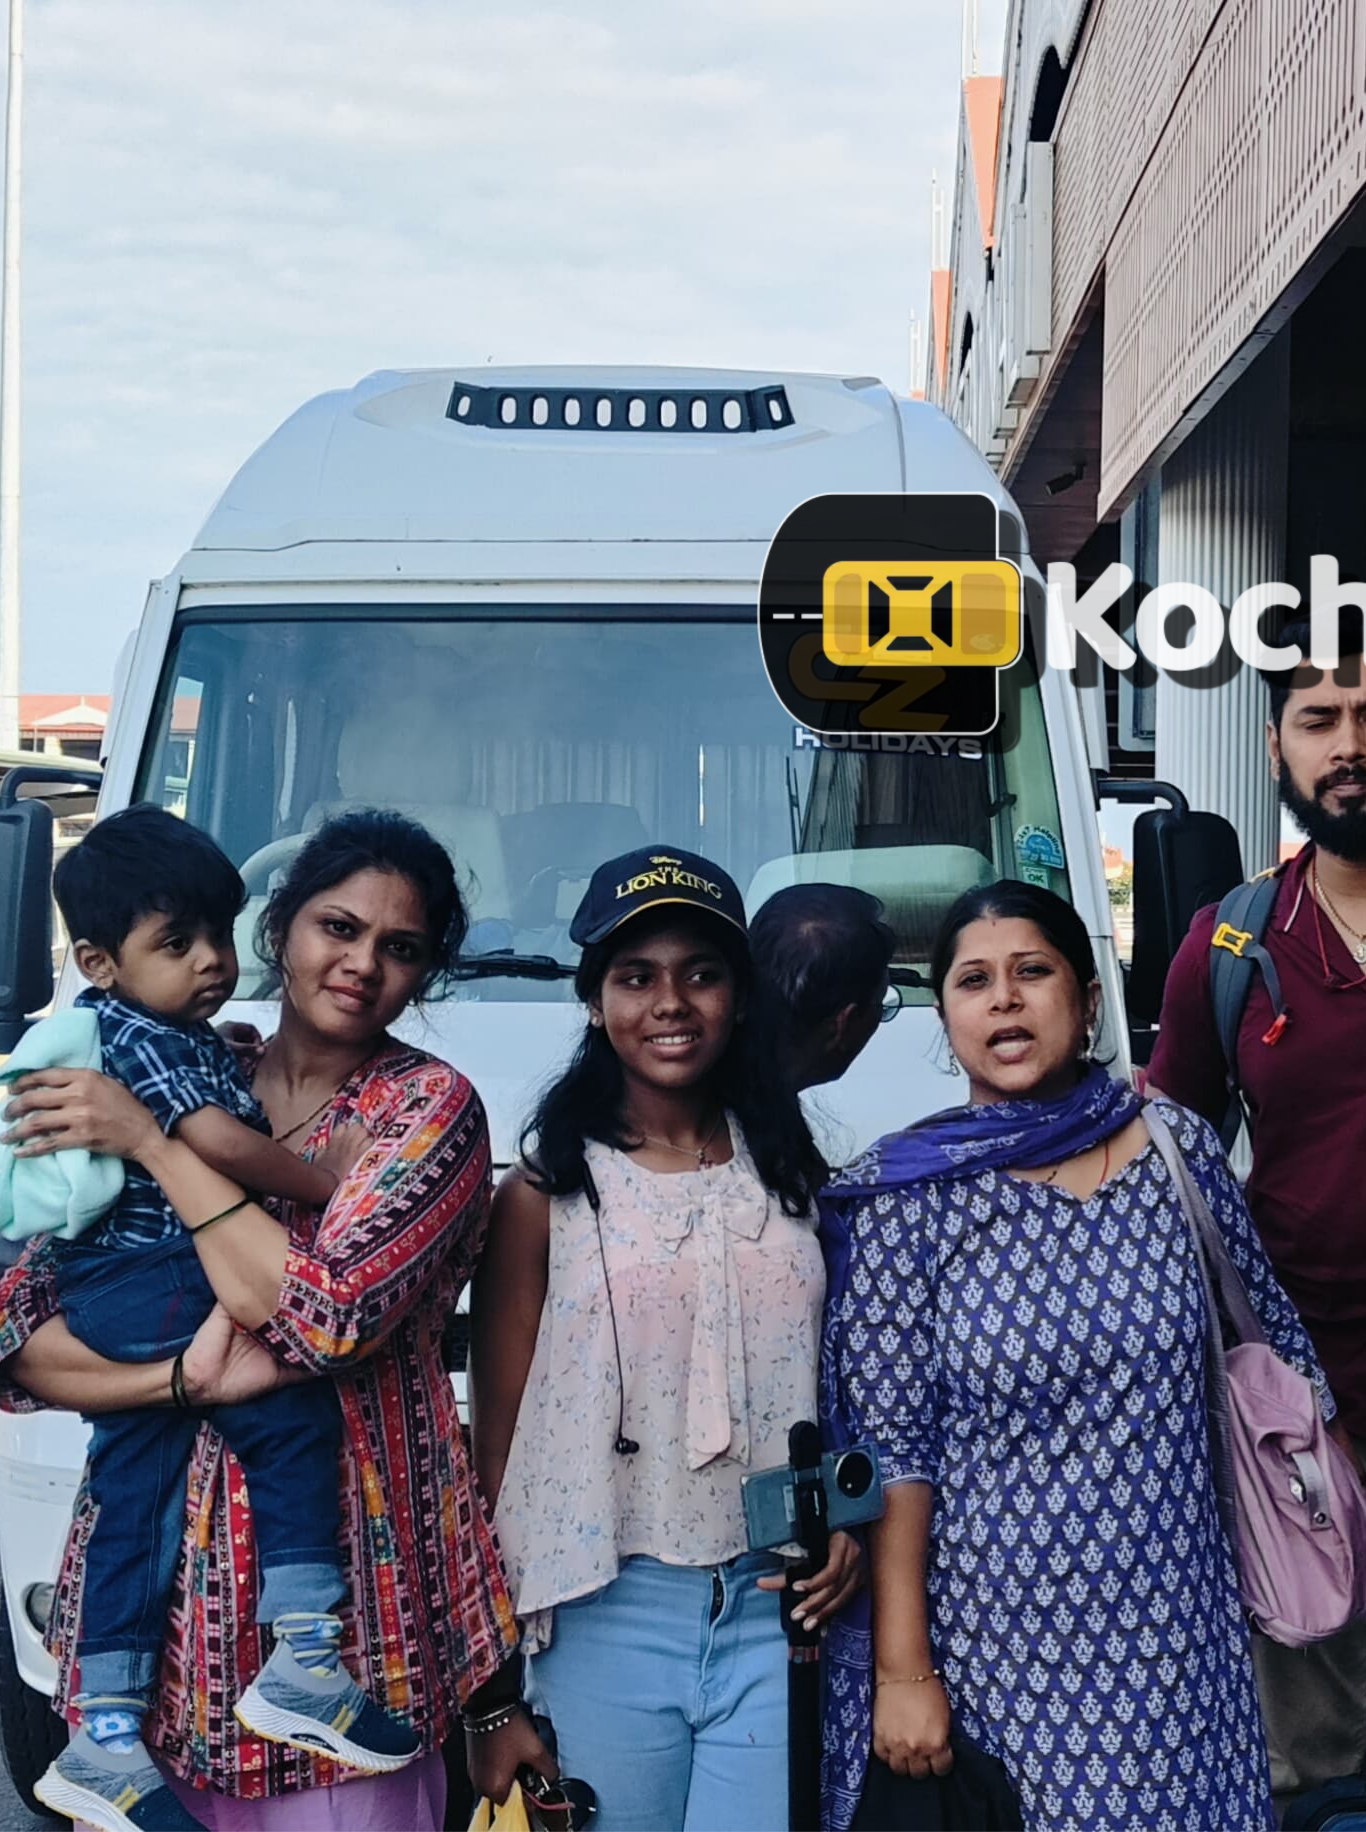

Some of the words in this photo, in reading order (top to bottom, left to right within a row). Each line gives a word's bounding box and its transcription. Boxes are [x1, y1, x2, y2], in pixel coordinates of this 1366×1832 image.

[794, 727, 983, 760] HOLIDAYS
[615, 870, 667, 899] LION
[671, 871, 723, 899] KING
[1027, 873, 1045, 883] OK
